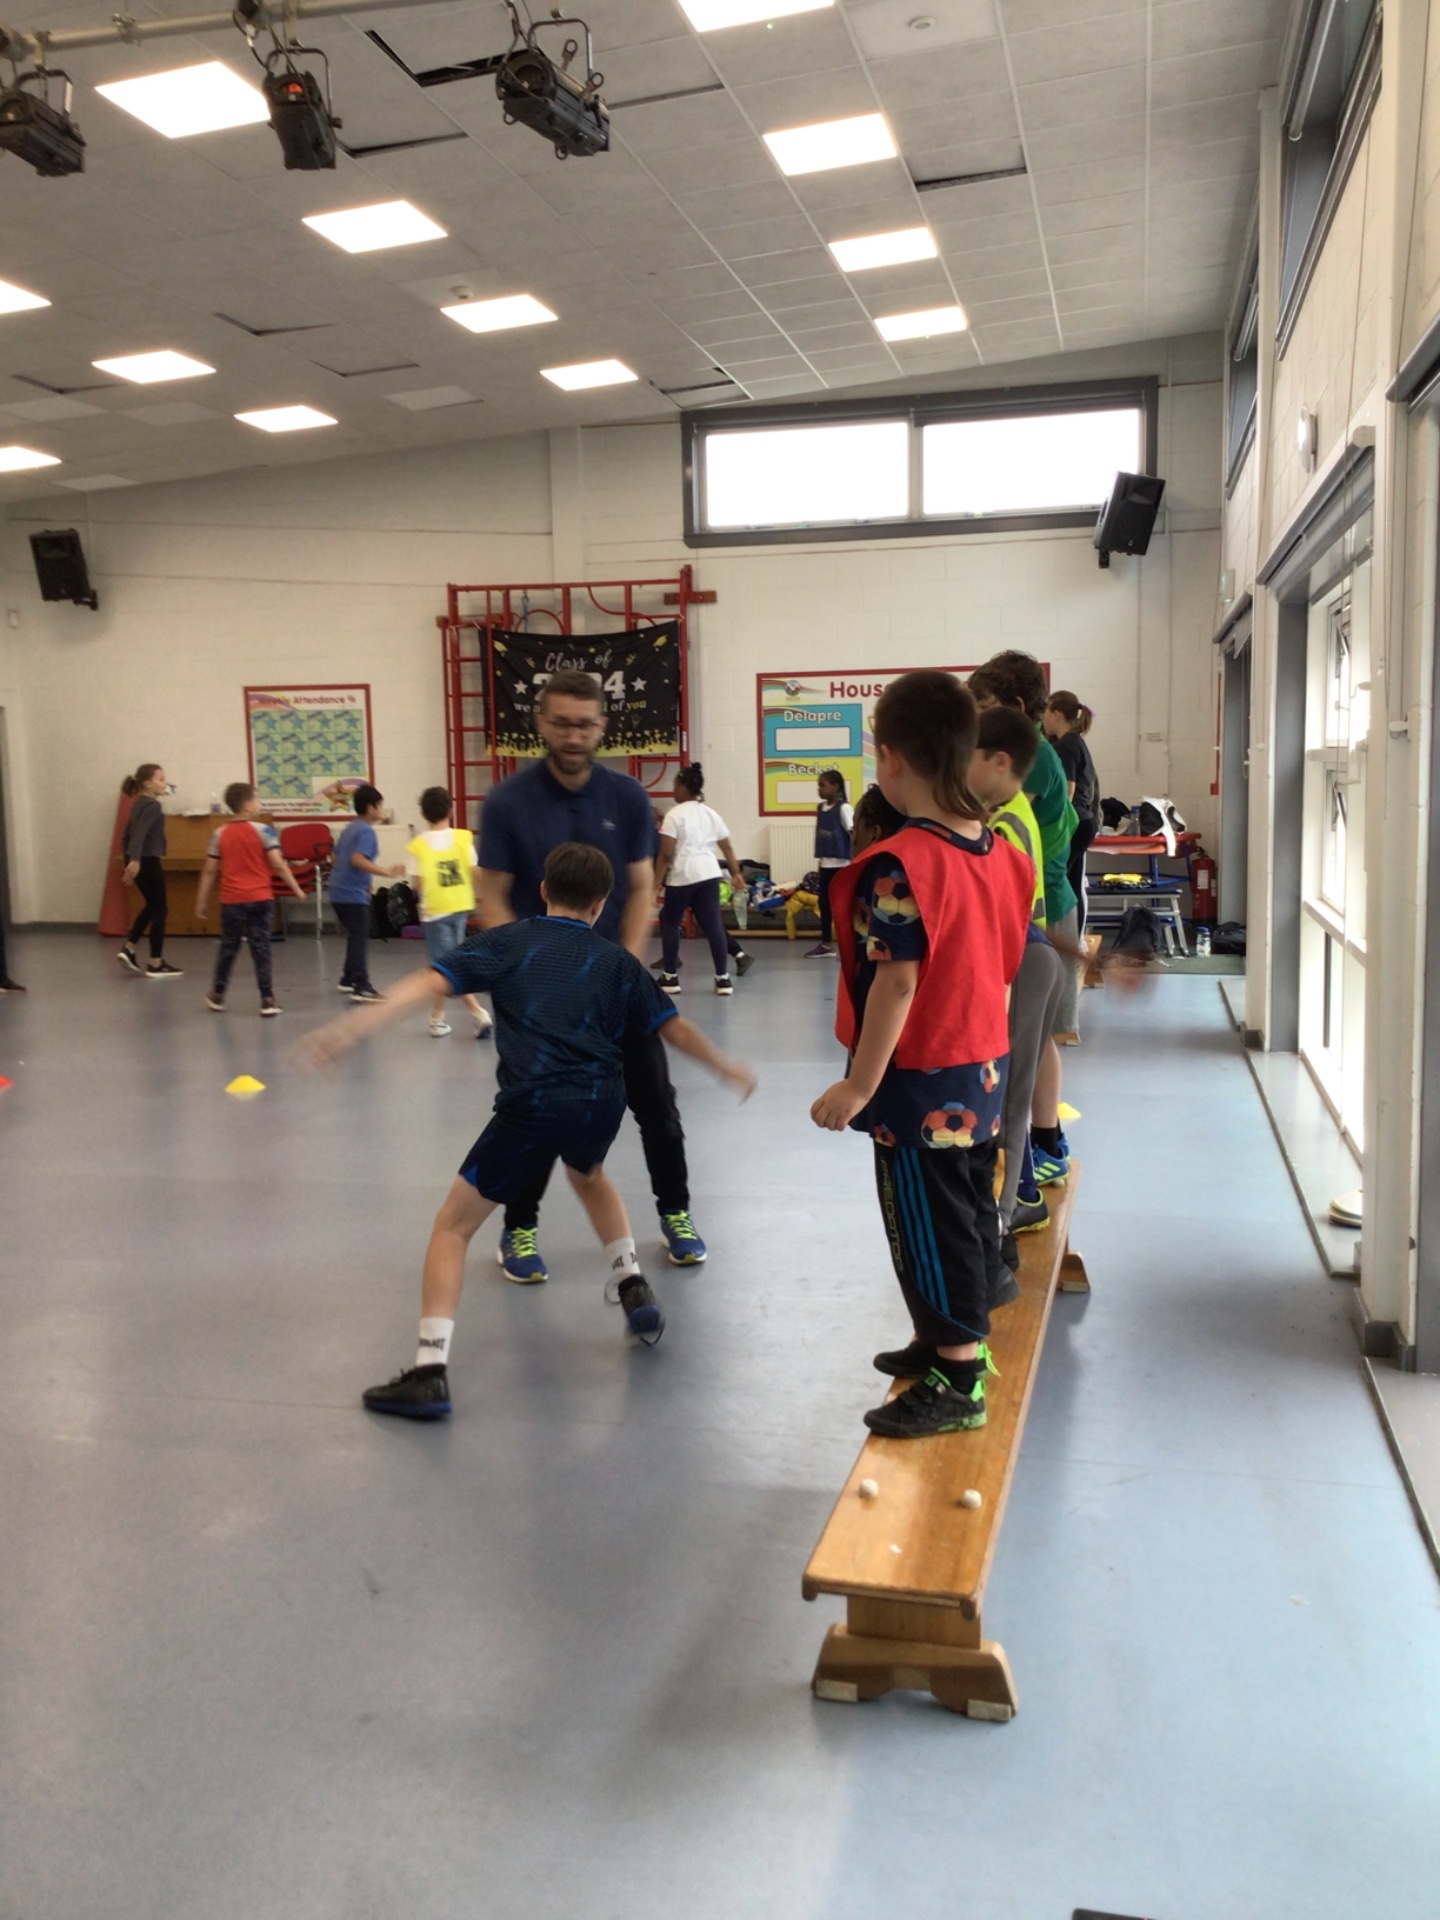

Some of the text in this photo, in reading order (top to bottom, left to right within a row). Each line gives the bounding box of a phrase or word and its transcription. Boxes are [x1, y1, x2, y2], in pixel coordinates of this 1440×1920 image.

[545, 648, 613, 671] Class of
[513, 703, 531, 713] we
[610, 700, 625, 712] of
[626, 701, 647, 713] you
[784, 710, 841, 723] Delapre
